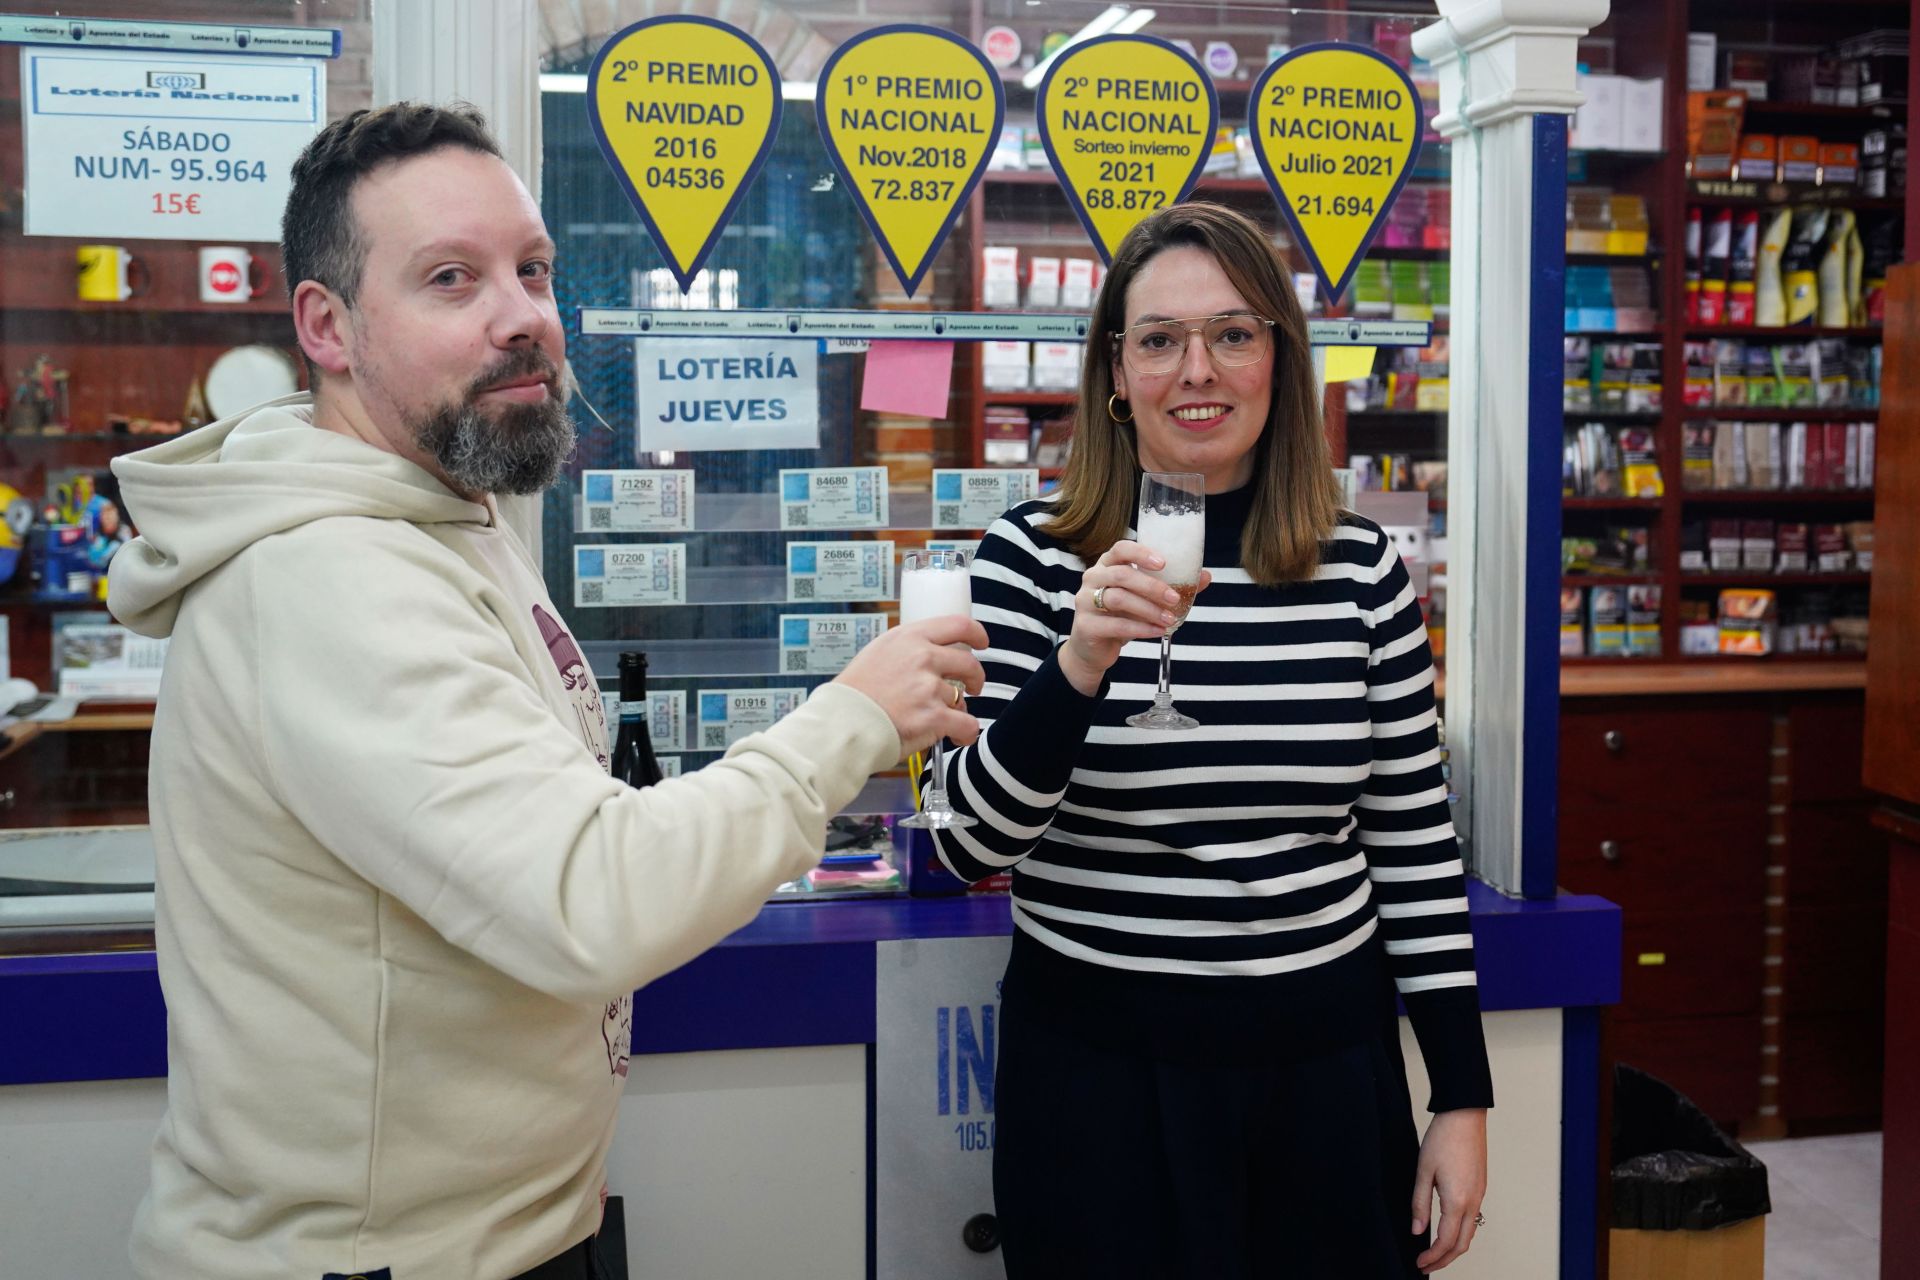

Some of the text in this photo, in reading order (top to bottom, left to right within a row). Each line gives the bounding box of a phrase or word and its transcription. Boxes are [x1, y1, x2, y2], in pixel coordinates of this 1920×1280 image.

[648, 62, 759, 87] PREMIO
[50, 86, 300, 102] Lotería Nacional
[876, 77, 983, 101] PREMIO
[1098, 78, 1200, 102] PREMIO
[1303, 87, 1402, 111] PREMIO
[625, 101, 745, 126] NAVIDAD
[841, 109, 985, 134] NACIONAL
[1062, 110, 1201, 135] NACIONAL
[123, 125, 231, 152] SÁBADO
[1270, 118, 1403, 142] NACIONAL
[654, 137, 717, 159] 2016
[859, 145, 967, 168] Nov.2018
[1074, 138, 1190, 157] Sorteo invierno
[75, 154, 267, 183] NUM- 95.964
[1099, 161, 1154, 183] 2021
[1281, 153, 1393, 176] Julio 2021
[646, 167, 725, 189] 04536
[871, 179, 955, 201] 72.837
[1086, 189, 1167, 210] 68.872
[152, 193, 202, 215] 15€
[1297, 195, 1374, 217] 21.694
[659, 352, 798, 380] LOTERÍA
[658, 398, 788, 423] JUEVES
[621, 479, 654, 489] 71292
[816, 476, 849, 486] 84680
[968, 477, 1000, 487] 08895
[612, 553, 645, 563] 07200
[823, 549, 855, 560] 26866
[816, 622, 847, 632] 71781
[734, 698, 767, 708] 01916
